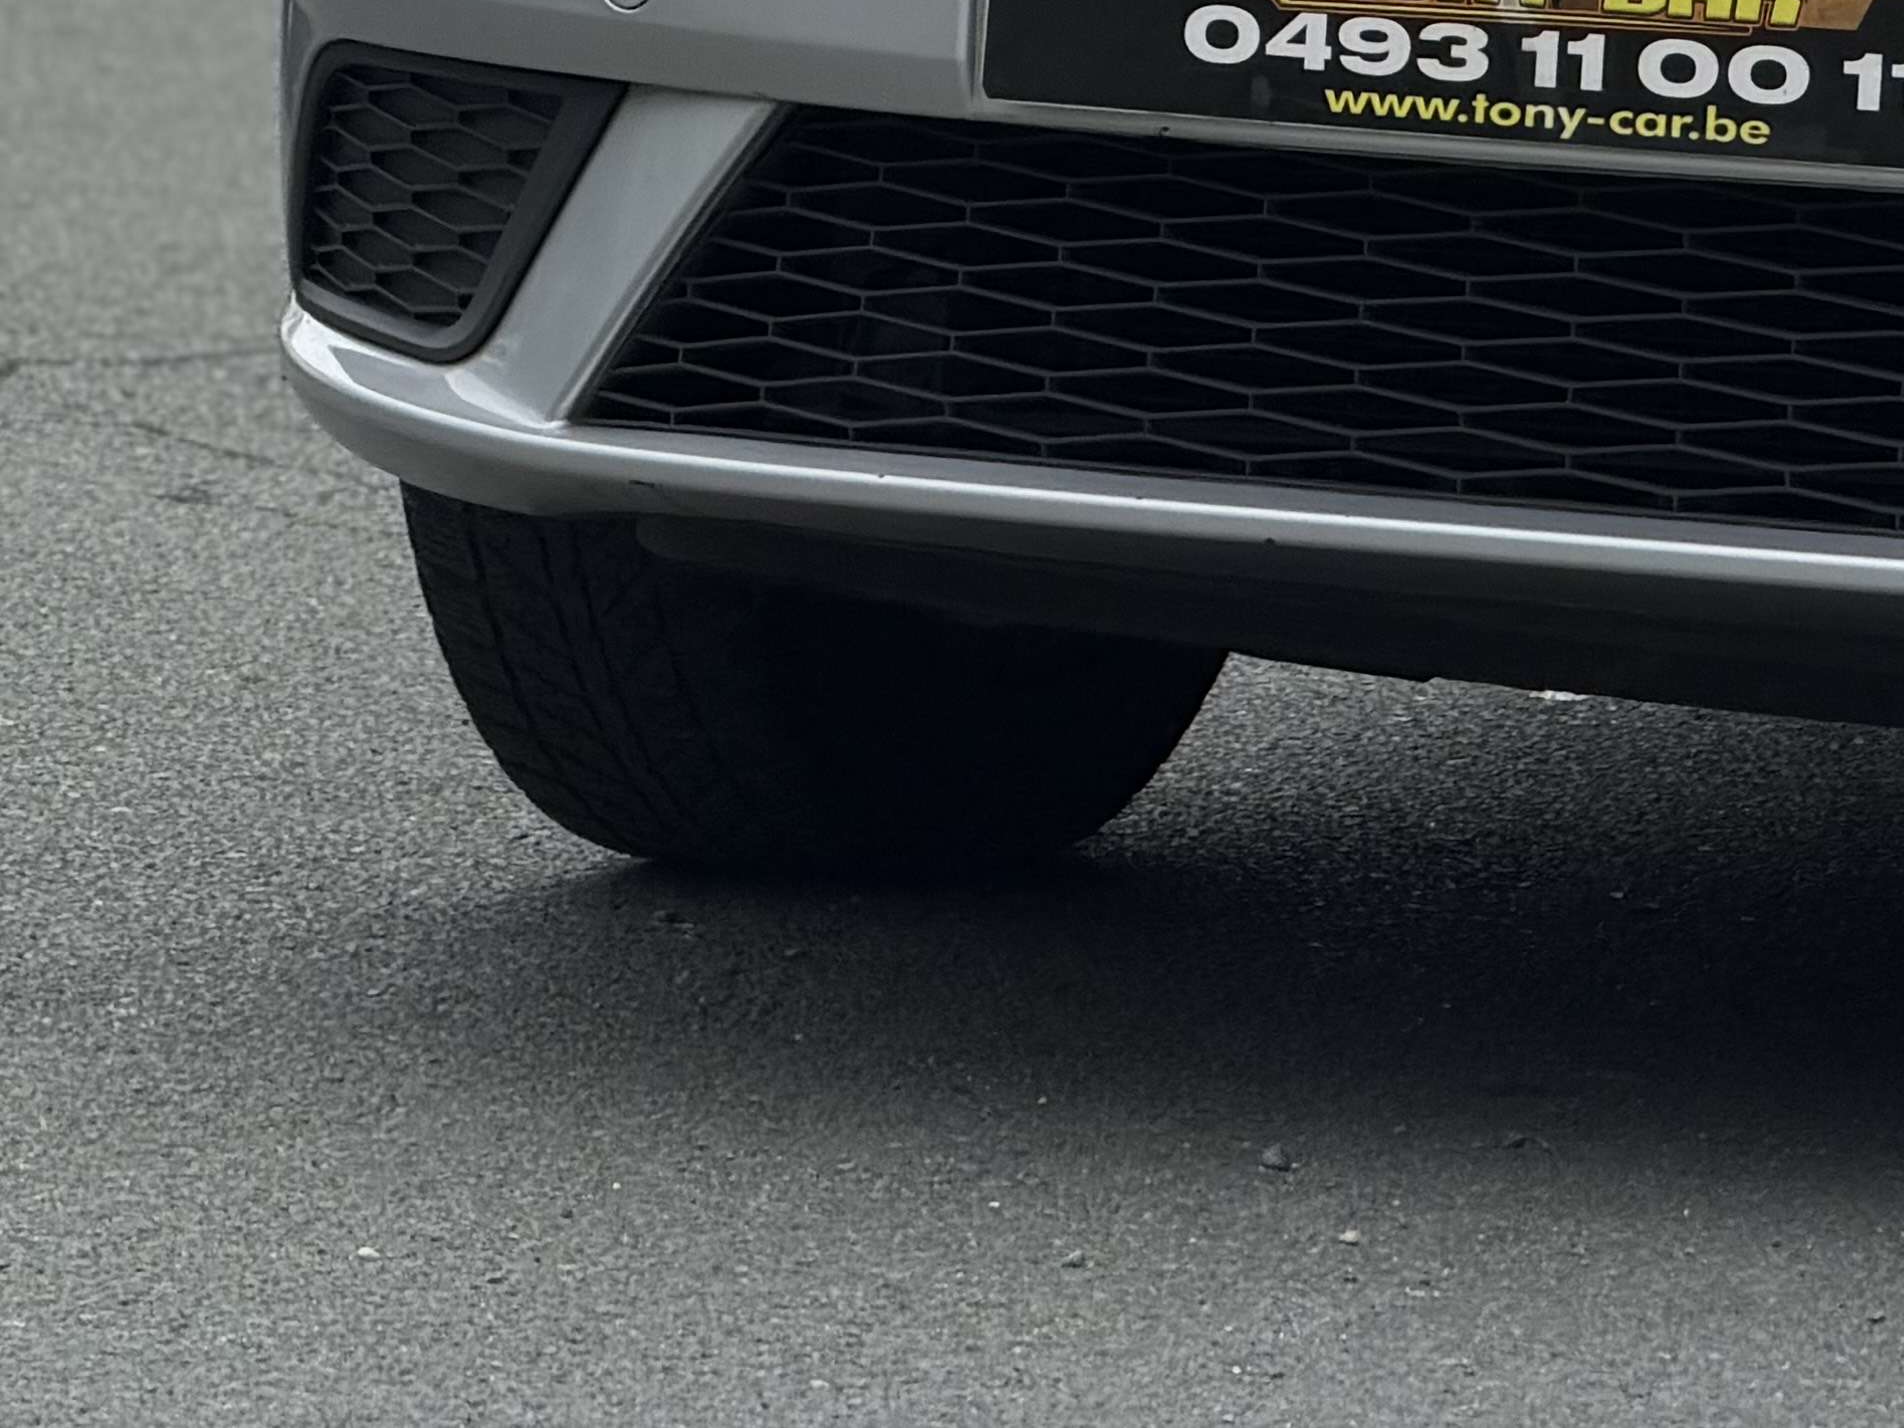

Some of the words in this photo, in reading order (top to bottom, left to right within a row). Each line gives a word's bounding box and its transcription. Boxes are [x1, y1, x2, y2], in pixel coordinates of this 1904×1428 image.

[1184, 4, 1489, 82] 0493
[1521, 30, 1606, 92] 11
[1638, 38, 1811, 105] 00
[1325, 88, 1771, 145] www.tony-car.be
